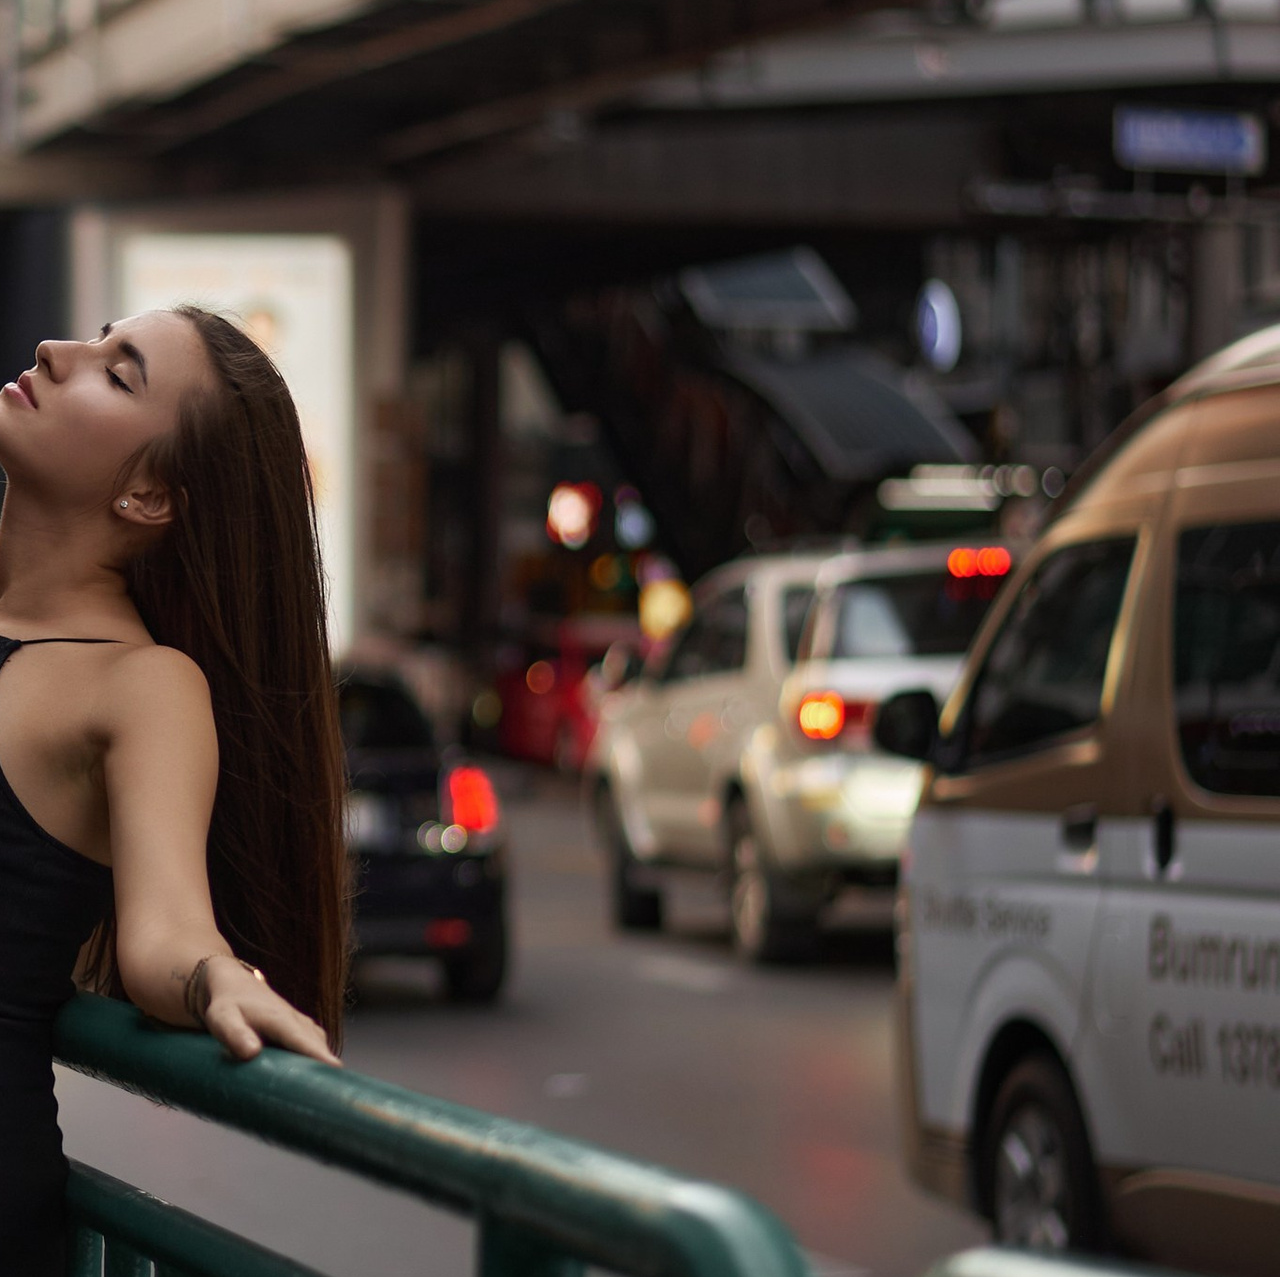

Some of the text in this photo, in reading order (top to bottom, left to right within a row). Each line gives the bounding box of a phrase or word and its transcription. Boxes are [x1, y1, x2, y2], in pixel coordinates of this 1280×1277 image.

[986, 897, 1050, 938] Service
[1147, 912, 1280, 994] Bumrun
[1148, 1010, 1207, 1077] Call
